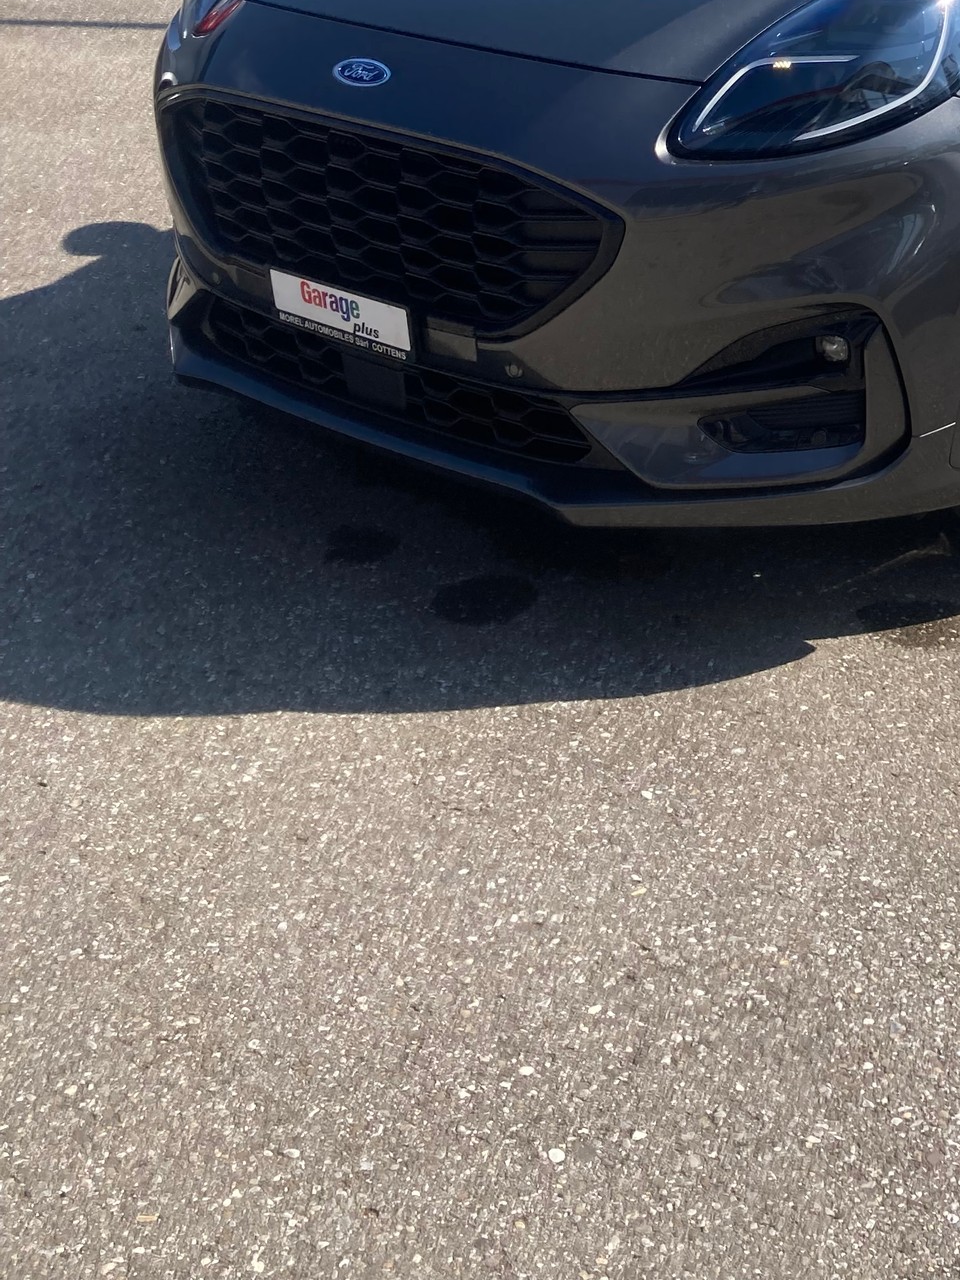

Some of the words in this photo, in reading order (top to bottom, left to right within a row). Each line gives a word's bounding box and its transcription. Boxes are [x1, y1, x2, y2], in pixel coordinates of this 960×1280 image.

[344, 63, 379, 81] Ford
[300, 280, 360, 322] Garage
[279, 312, 304, 327] MOREL
[304, 321, 354, 344] AUTOMOBILES
[371, 342, 407, 360] COTTENS
[353, 322, 379, 338] plus
